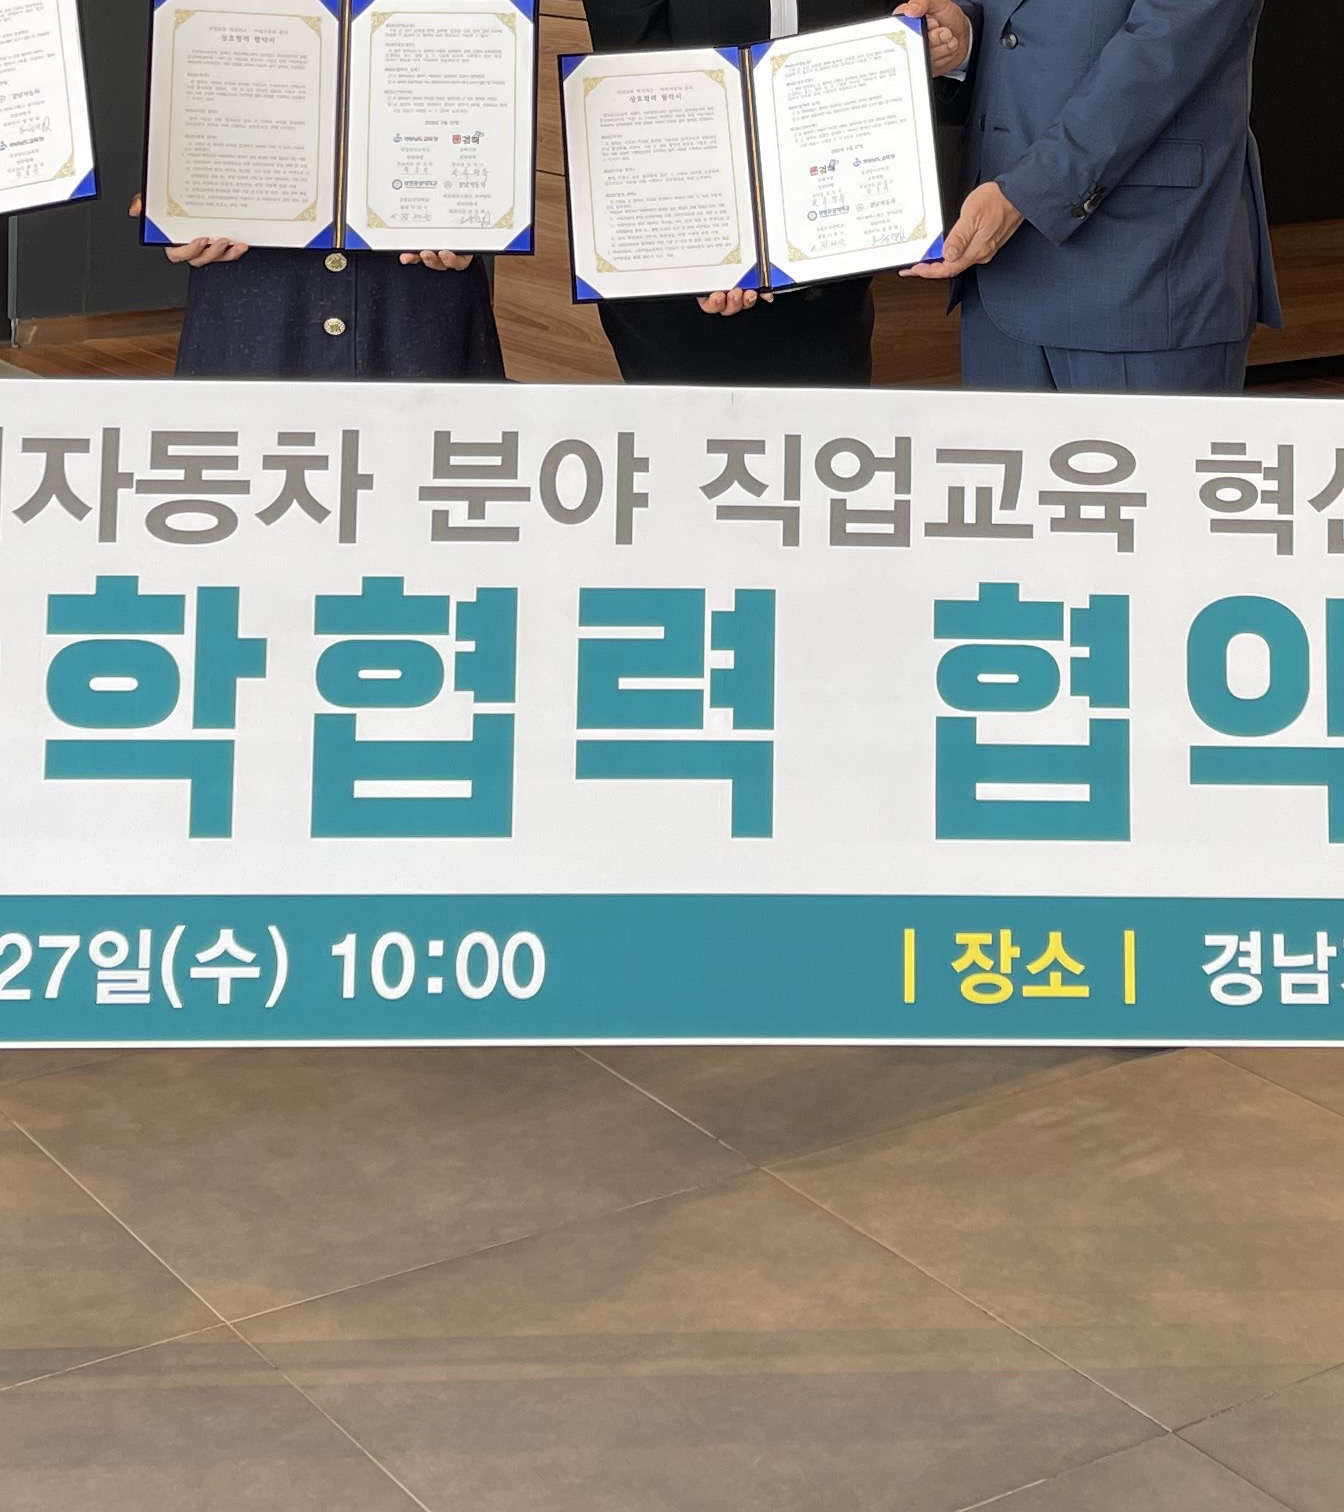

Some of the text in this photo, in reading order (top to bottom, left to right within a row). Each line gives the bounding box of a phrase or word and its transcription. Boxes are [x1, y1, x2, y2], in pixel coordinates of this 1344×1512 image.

[418, 430, 651, 546] 분야
[699, 433, 1148, 554] 직업교육
[331, 932, 548, 1002] 10:00
[952, 930, 1092, 1006] 장소
